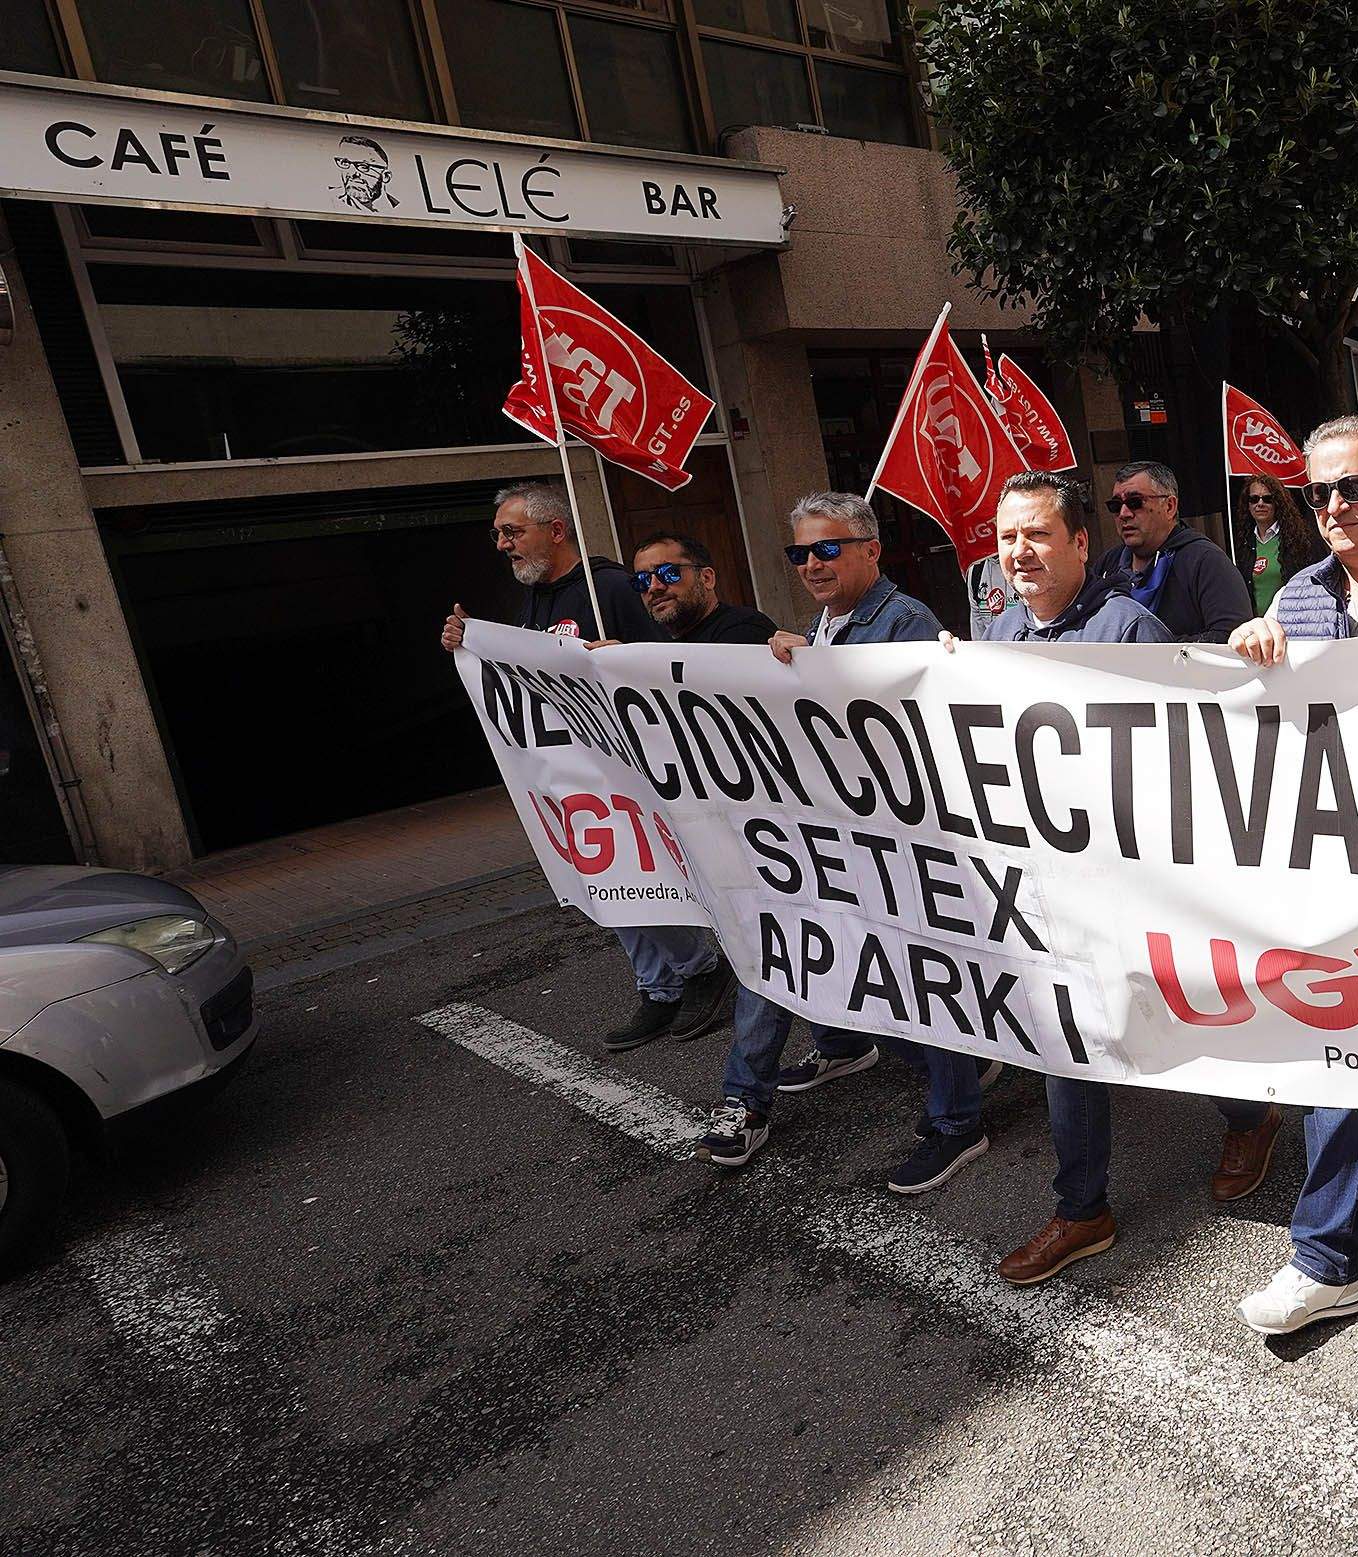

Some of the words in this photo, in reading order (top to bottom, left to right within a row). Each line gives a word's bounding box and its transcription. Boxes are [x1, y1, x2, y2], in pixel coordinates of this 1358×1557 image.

[45, 122, 230, 181] CAFÉ
[415, 153, 569, 222] LELÉ
[642, 181, 721, 219] BAR
[528, 790, 656, 875] UGT
[587, 882, 684, 903] Pontevedra,
[743, 817, 1050, 954] SETEX
